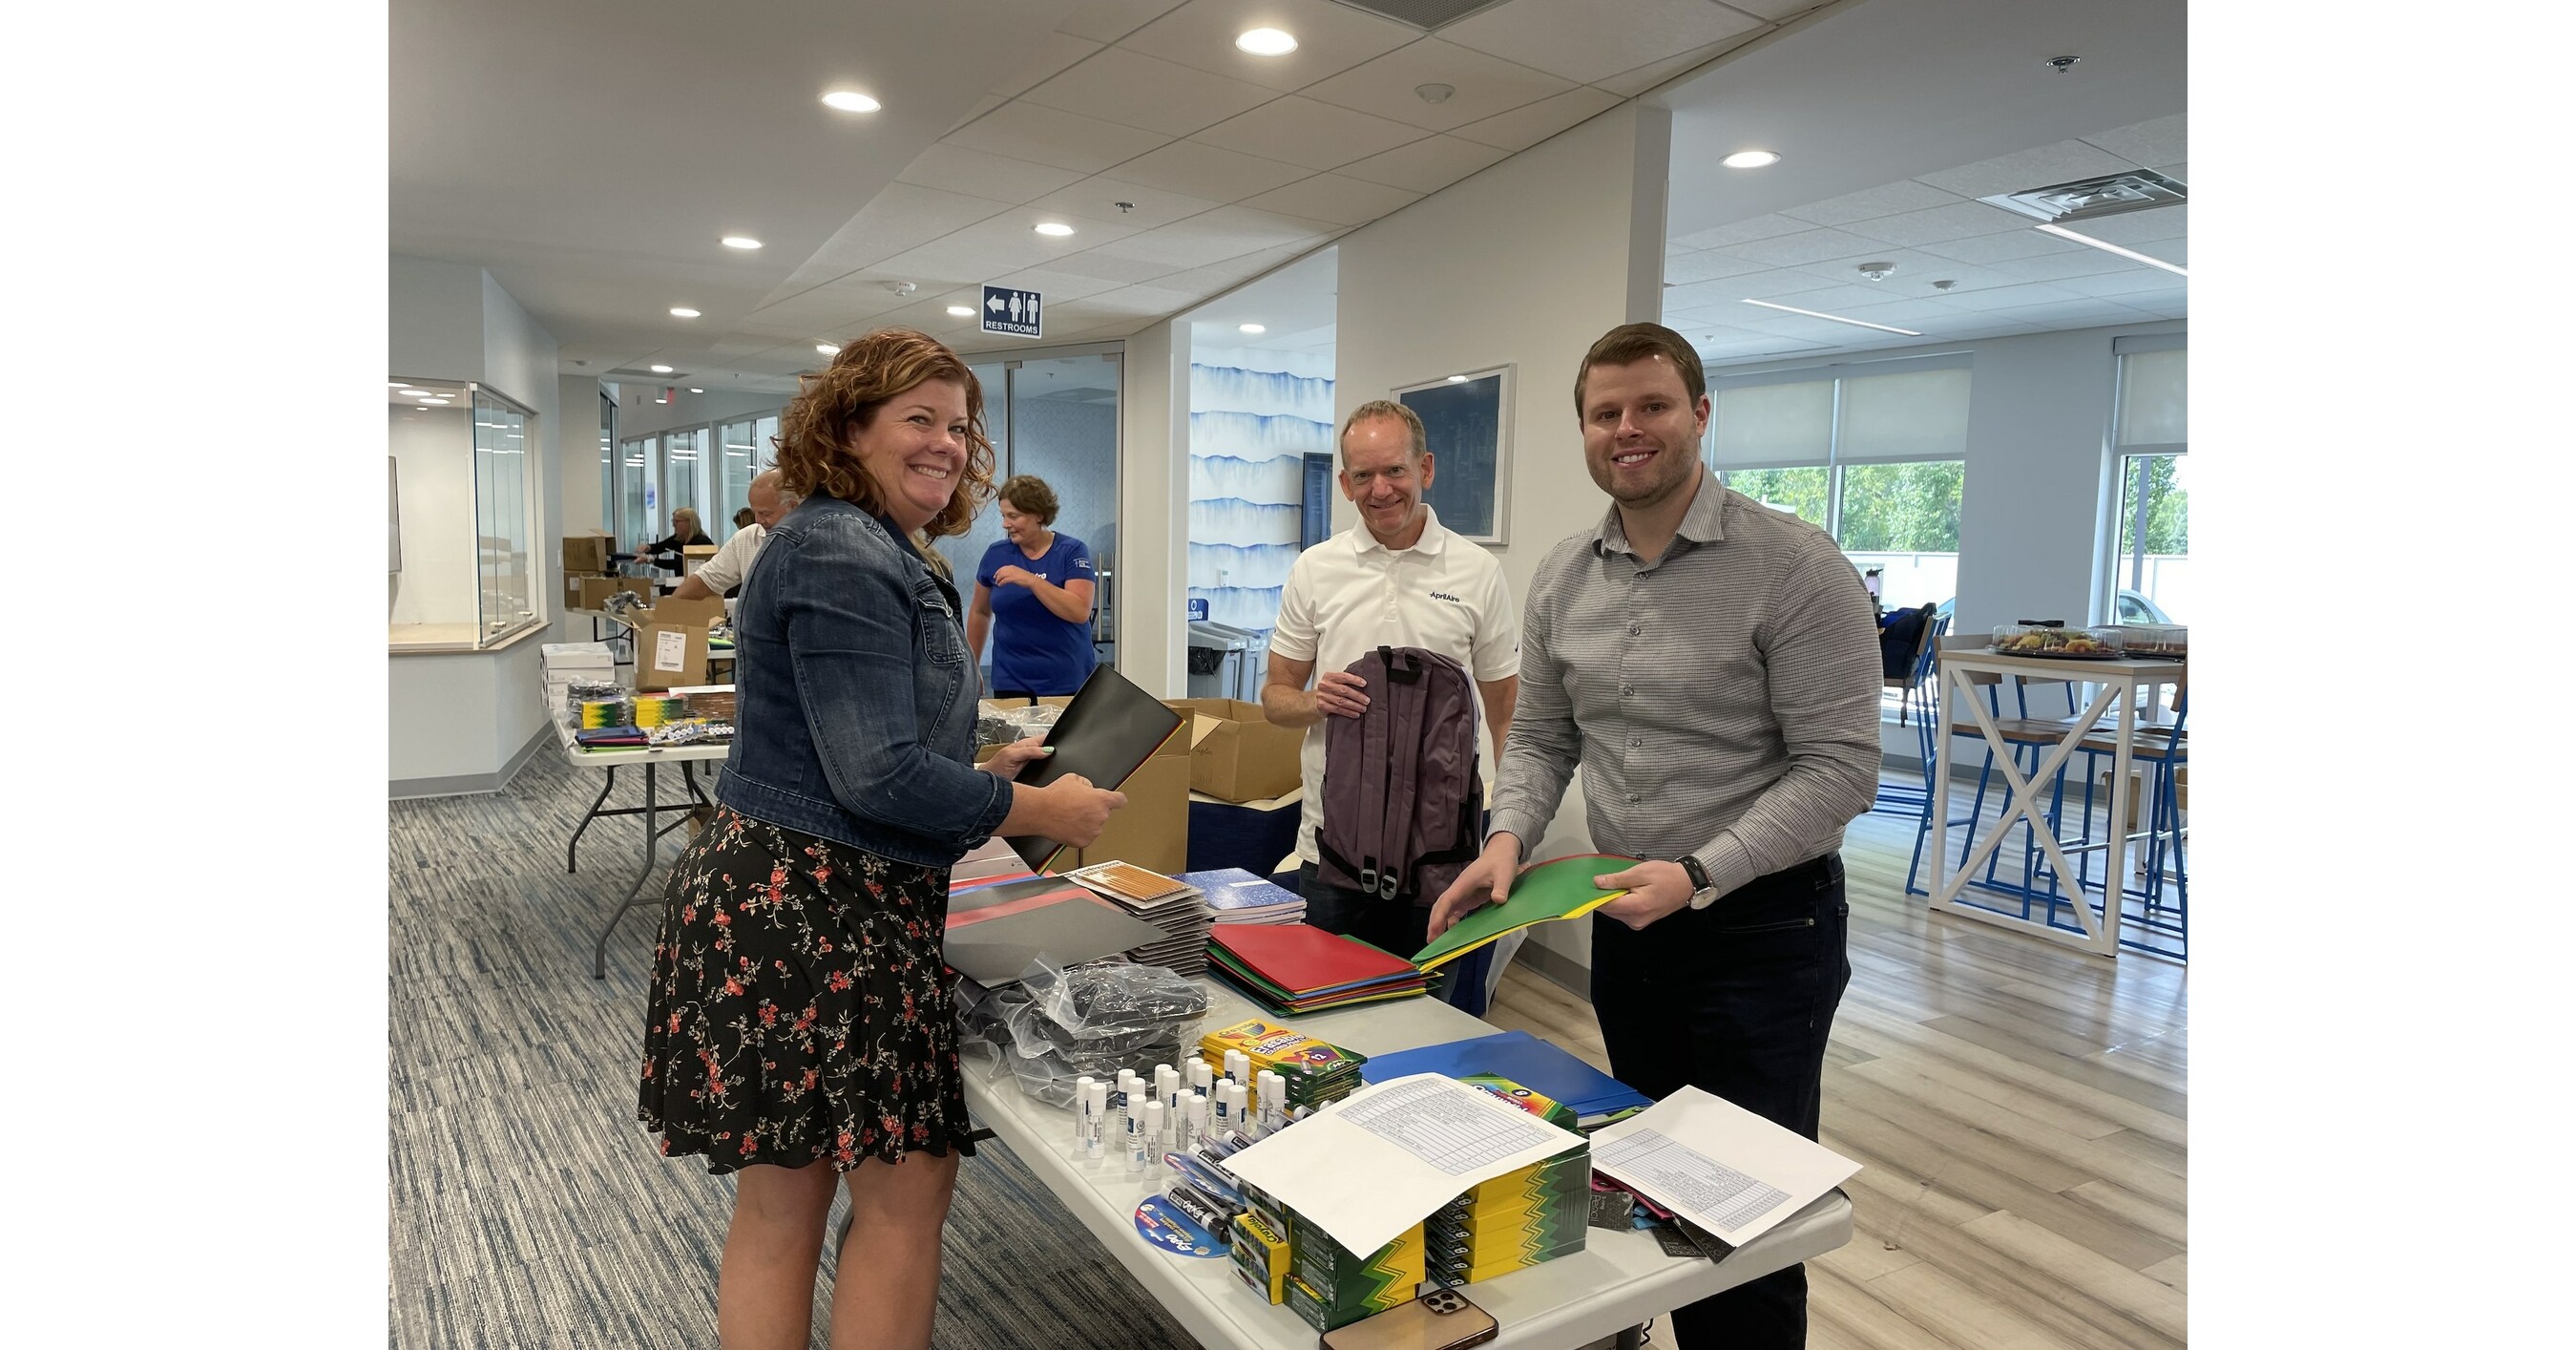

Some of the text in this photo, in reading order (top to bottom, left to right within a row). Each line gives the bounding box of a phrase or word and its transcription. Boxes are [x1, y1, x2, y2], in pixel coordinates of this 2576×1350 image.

[985, 321, 1038, 334] RESTROOMS
[1430, 591, 1460, 603] AprilAire
[1310, 1053, 1327, 1062] 12
[1182, 1199, 1206, 1218] EXPO
[1590, 1194, 1602, 1222] Pencil
[1248, 1214, 1278, 1243] Crayola
[1164, 1234, 1194, 1252] EXPO
